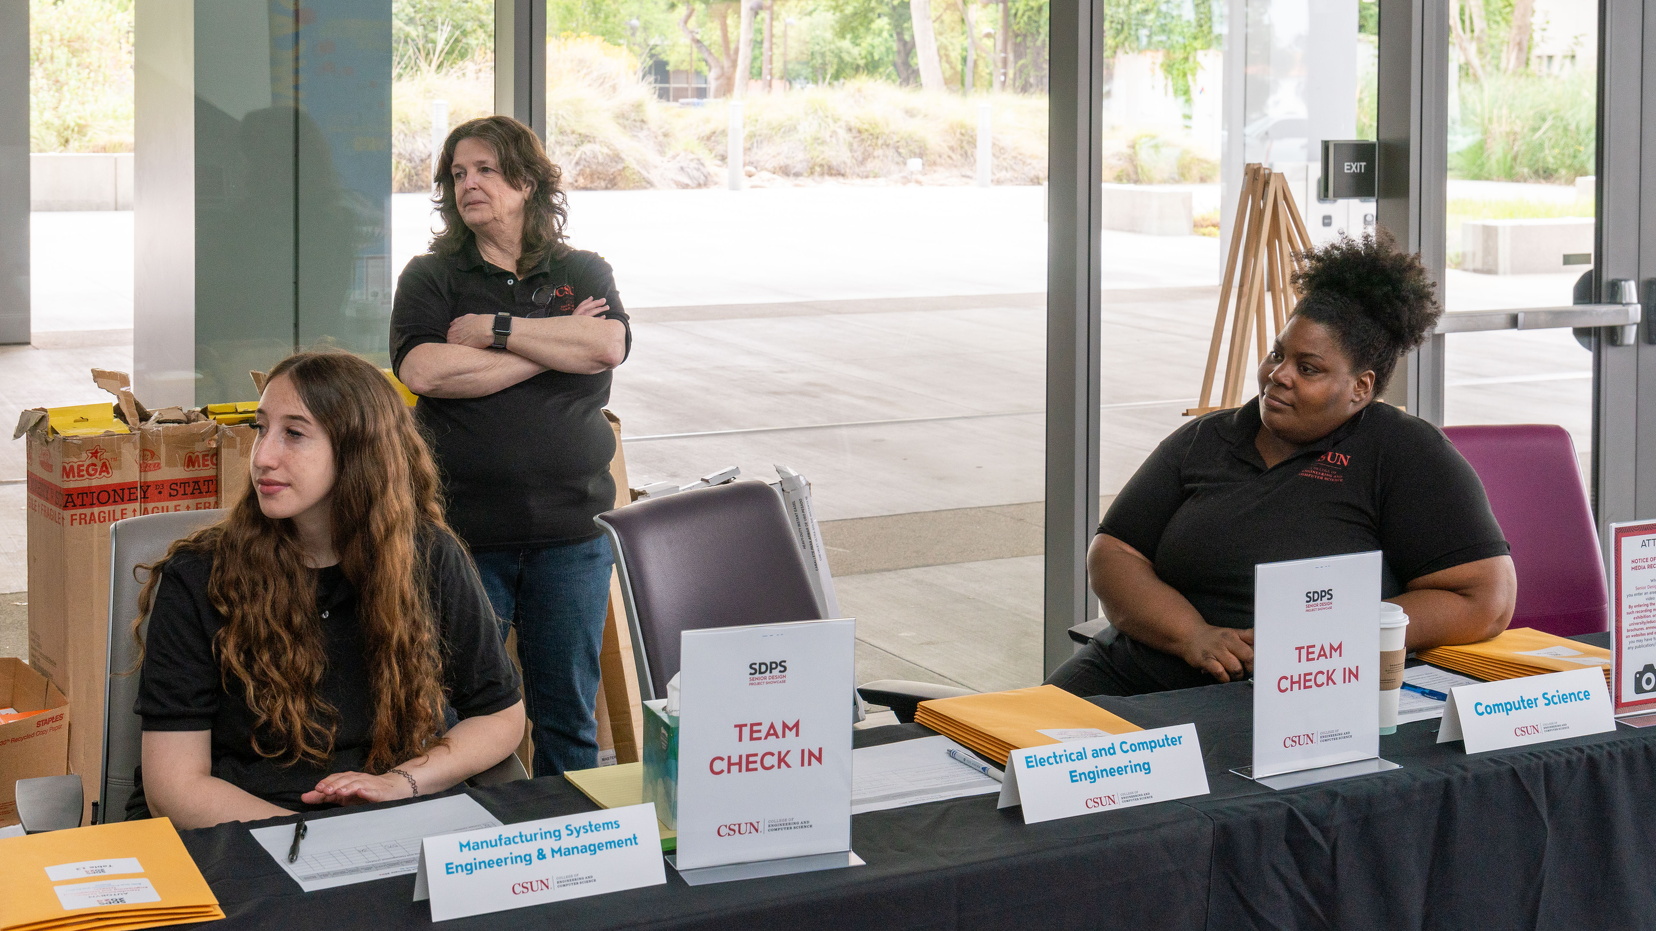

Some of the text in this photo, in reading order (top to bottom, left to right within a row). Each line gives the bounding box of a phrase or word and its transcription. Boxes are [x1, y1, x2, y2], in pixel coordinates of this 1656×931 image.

[1344, 162, 1366, 173] EXIT
[62, 464, 111, 479] MEGA
[70, 508, 128, 526] FRAGILE
[1641, 539, 1656, 548] ATT
[1305, 588, 1334, 603] SDPS
[1295, 641, 1343, 663] TEAM
[749, 660, 787, 675] SDPS
[1277, 666, 1359, 693] CHECK IN
[1474, 689, 1591, 716] Computer Science
[36, 713, 64, 728] STAPLES
[11, 732, 35, 743] Recycled
[36, 729, 48, 737] Copy
[734, 719, 800, 742] TEAM
[1514, 724, 1539, 737] CSUN
[1283, 733, 1314, 749] CSUN
[1024, 747, 1088, 769] Electrical
[1091, 743, 1117, 758] and
[1119, 734, 1183, 754] Computer
[709, 747, 823, 775] CHECK IN
[1069, 760, 1151, 783] Engineering
[1085, 795, 1116, 809] CSUN
[459, 827, 562, 853] Manufacturing
[565, 819, 621, 839] Systems
[717, 821, 760, 837] CSUN
[445, 850, 533, 875] Engineering
[536, 848, 547, 860] &
[550, 833, 639, 858] Management
[512, 878, 549, 895] CSUN
